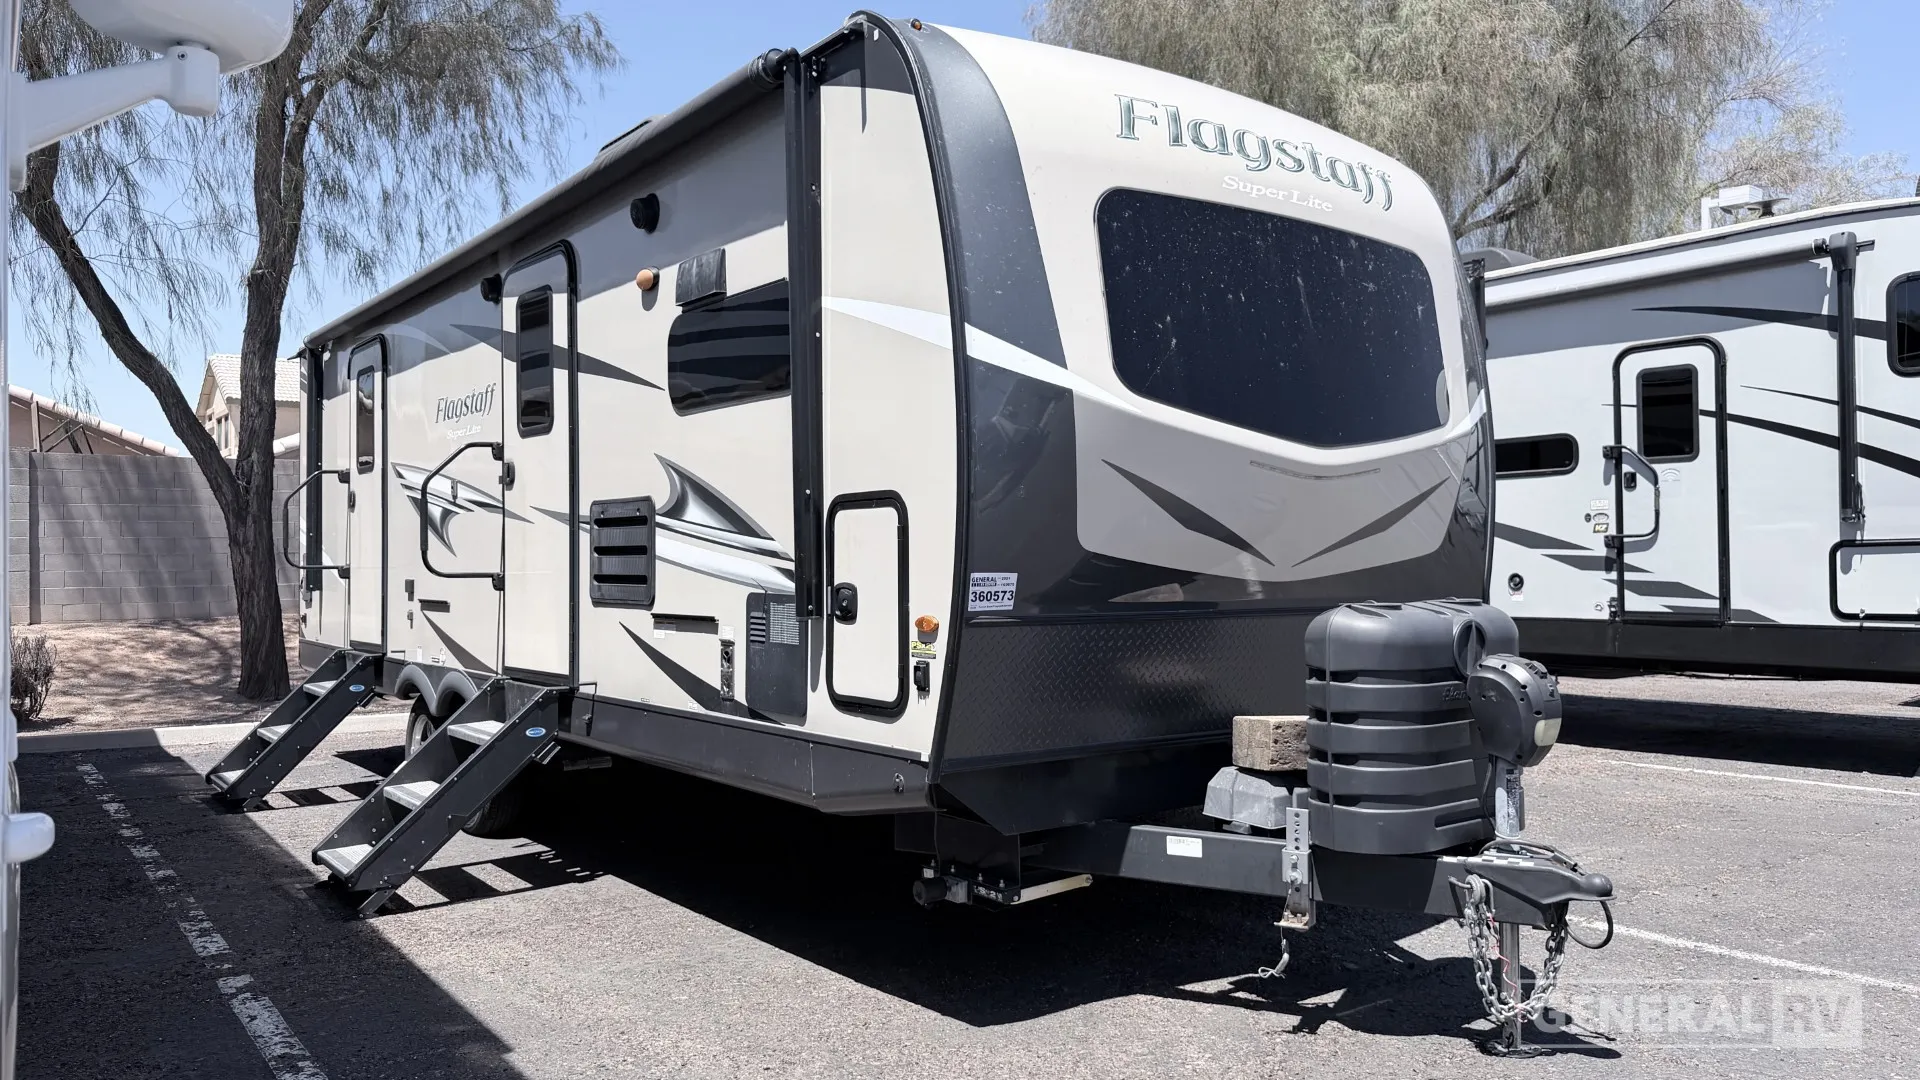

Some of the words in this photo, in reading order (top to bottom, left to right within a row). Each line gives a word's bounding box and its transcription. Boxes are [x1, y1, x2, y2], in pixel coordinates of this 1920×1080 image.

[1113, 93, 1393, 212] Flagstaff
[1221, 174, 1288, 201] Super
[1290, 188, 1334, 212] Lite
[435, 382, 497, 424] Flagstaff
[970, 590, 1014, 602] 360573
